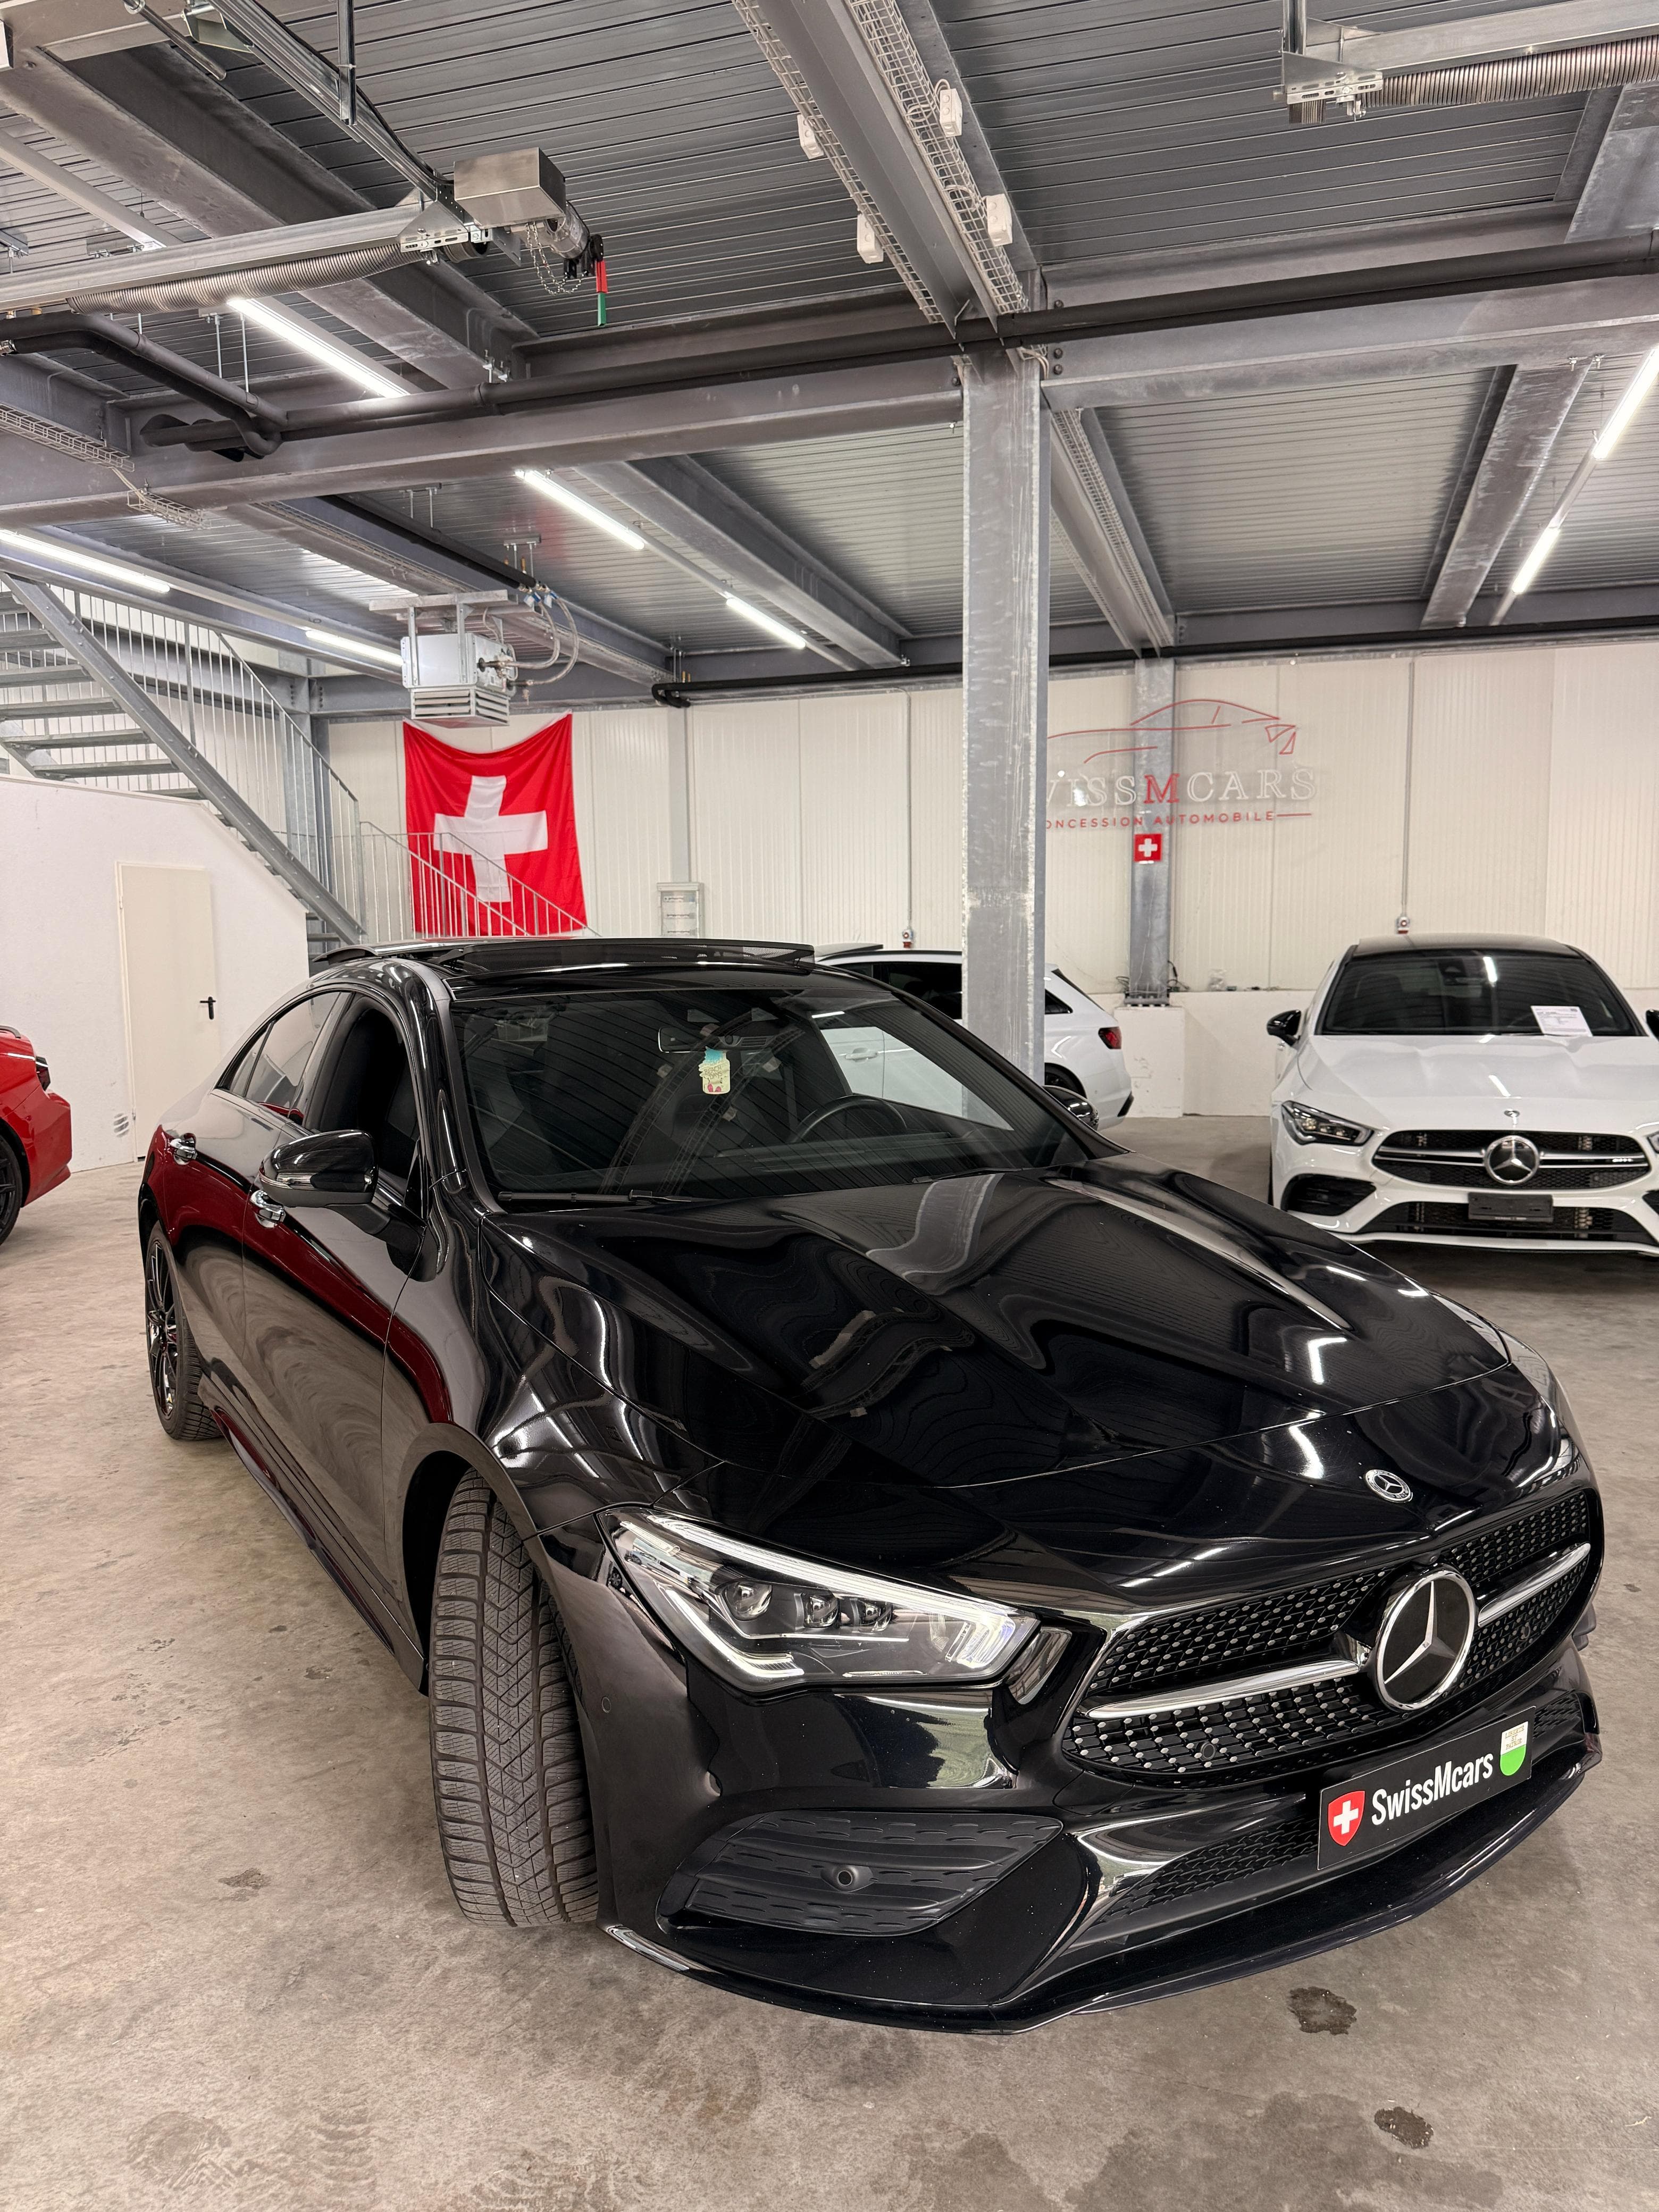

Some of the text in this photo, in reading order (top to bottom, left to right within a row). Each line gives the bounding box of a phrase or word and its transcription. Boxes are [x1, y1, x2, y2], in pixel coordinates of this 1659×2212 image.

[1046, 768, 1316, 807] ISSMCARS
[1046, 811, 1275, 829] ONCESSION AUTOMOBILE
[704, 1065, 722, 1075] BEACH
[1505, 1738, 1522, 1750] PATRIE
[1371, 1753, 1494, 1825] SwissMcars
